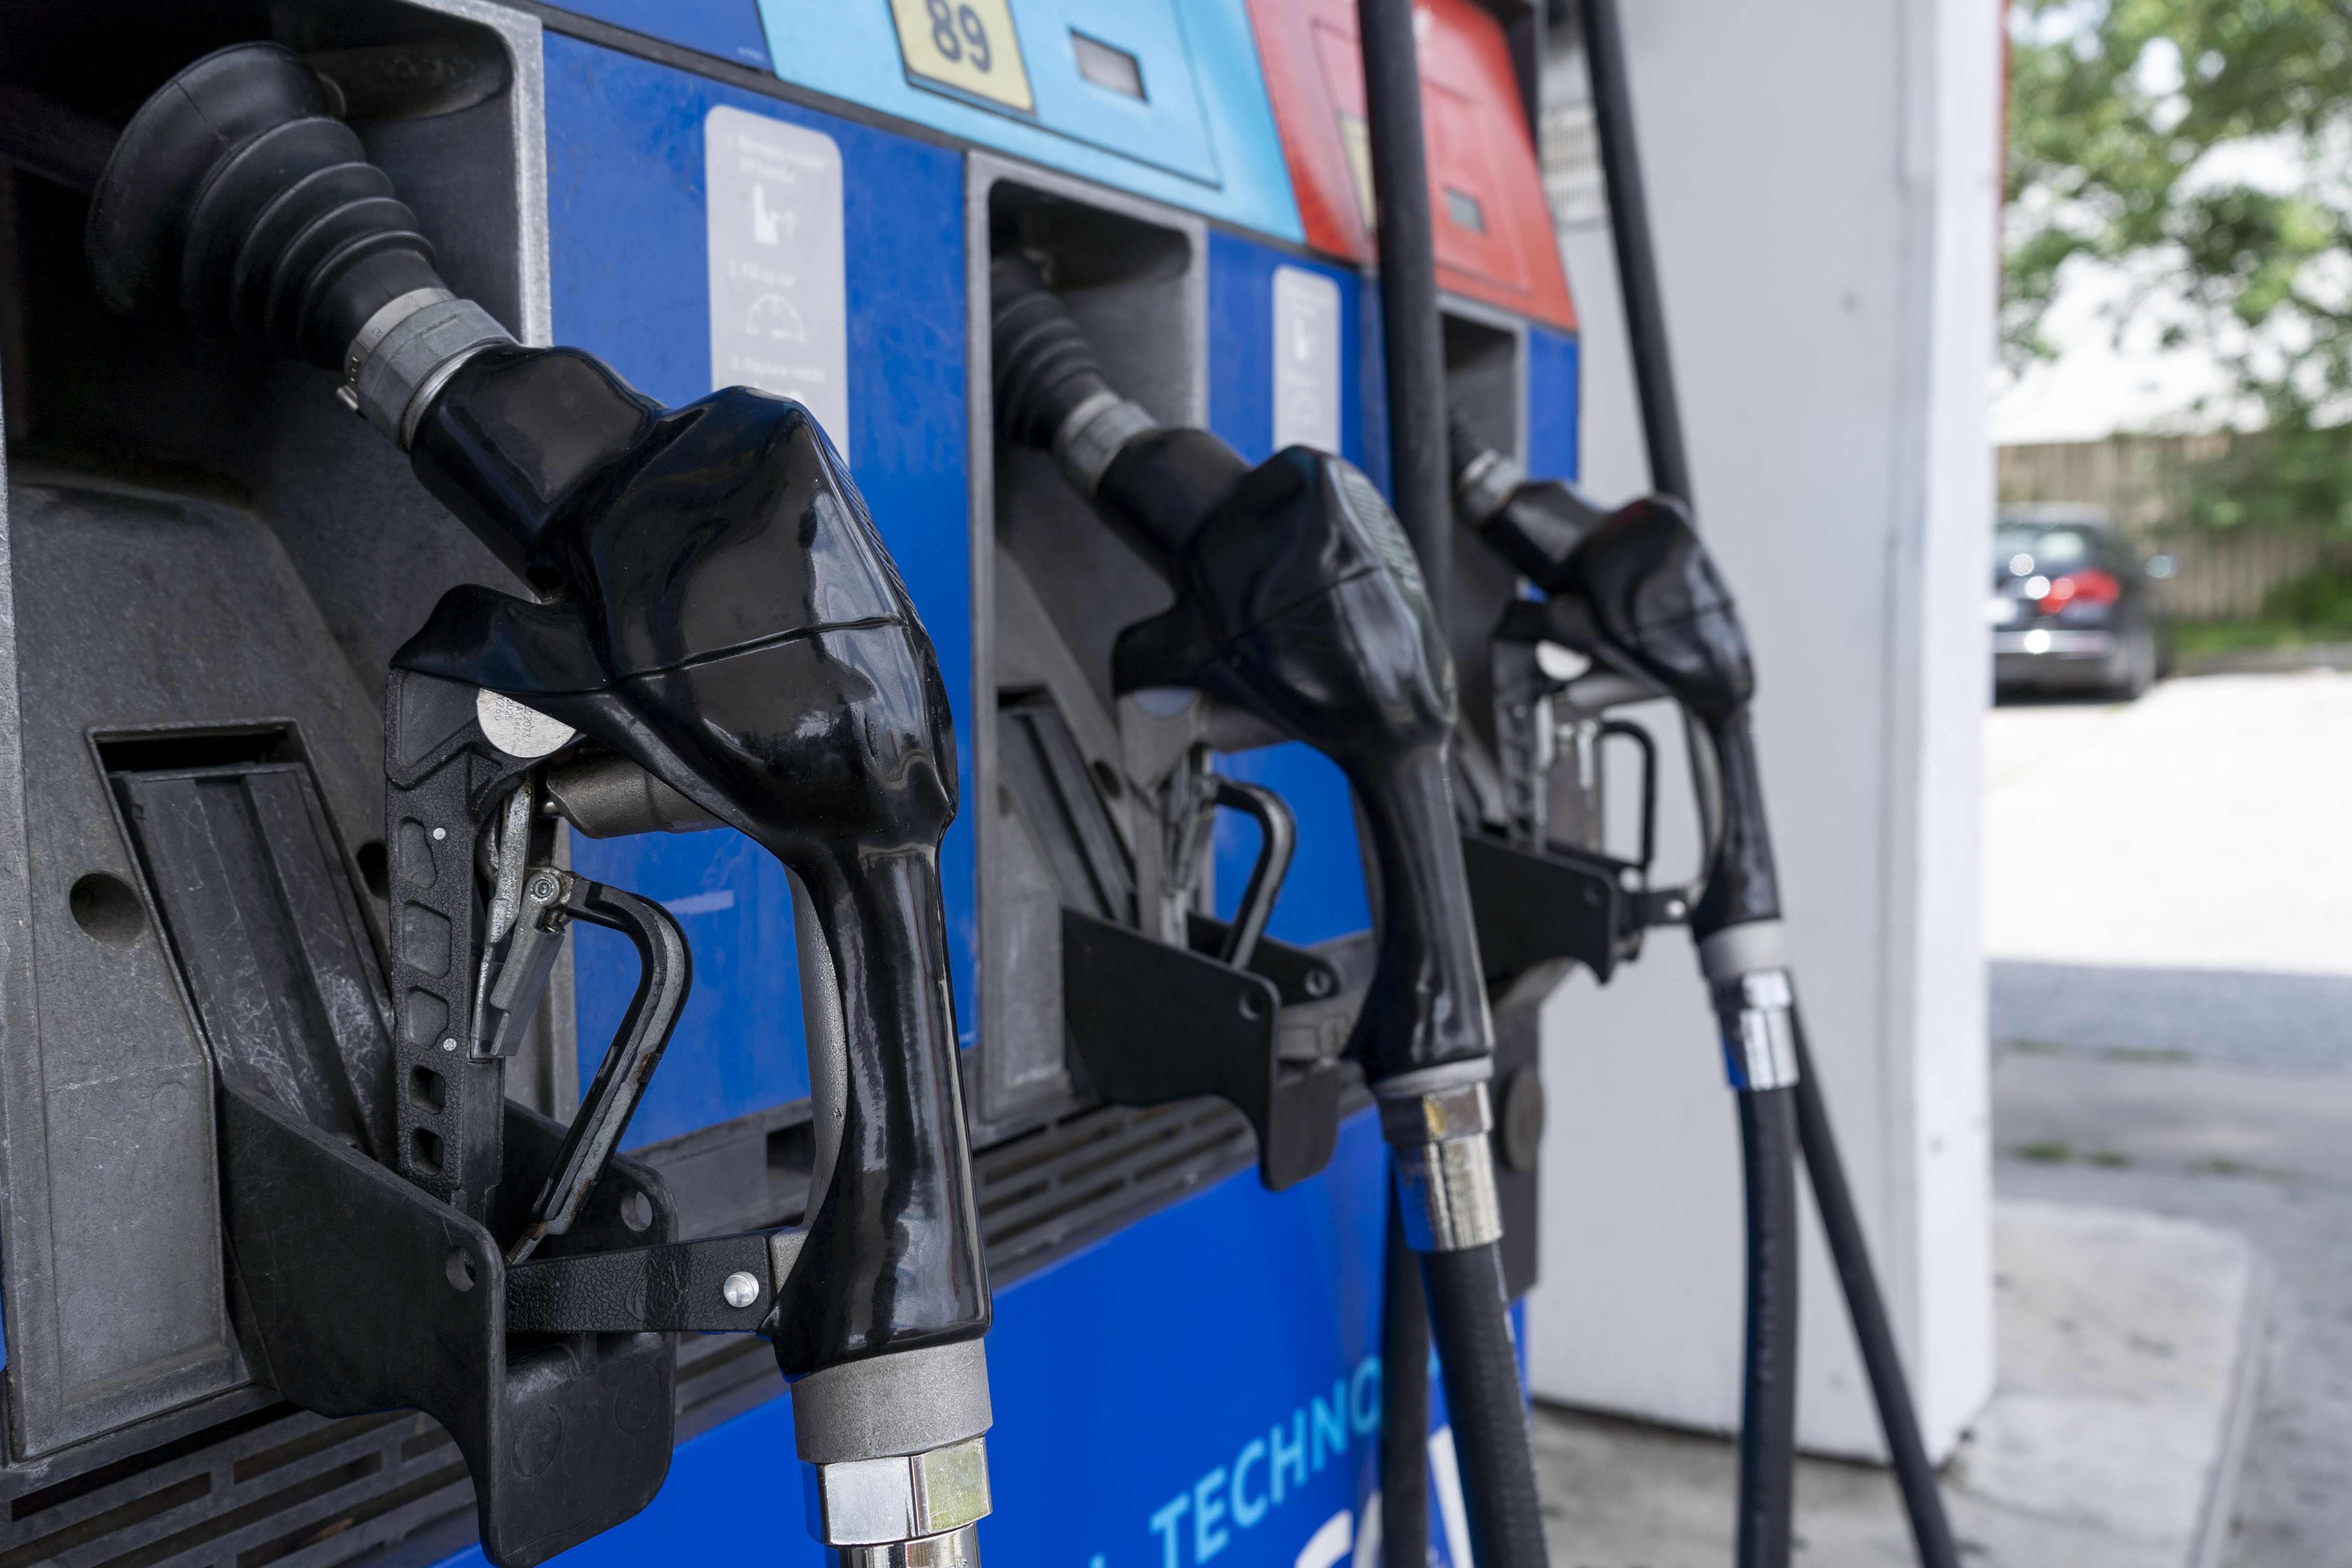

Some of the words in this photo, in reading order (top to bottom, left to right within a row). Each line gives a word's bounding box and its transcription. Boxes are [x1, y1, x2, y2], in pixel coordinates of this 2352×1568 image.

[926, 0, 991, 74] 89
[505, 699, 514, 721] 2025
[1148, 1343, 1441, 1568] TECHNO
